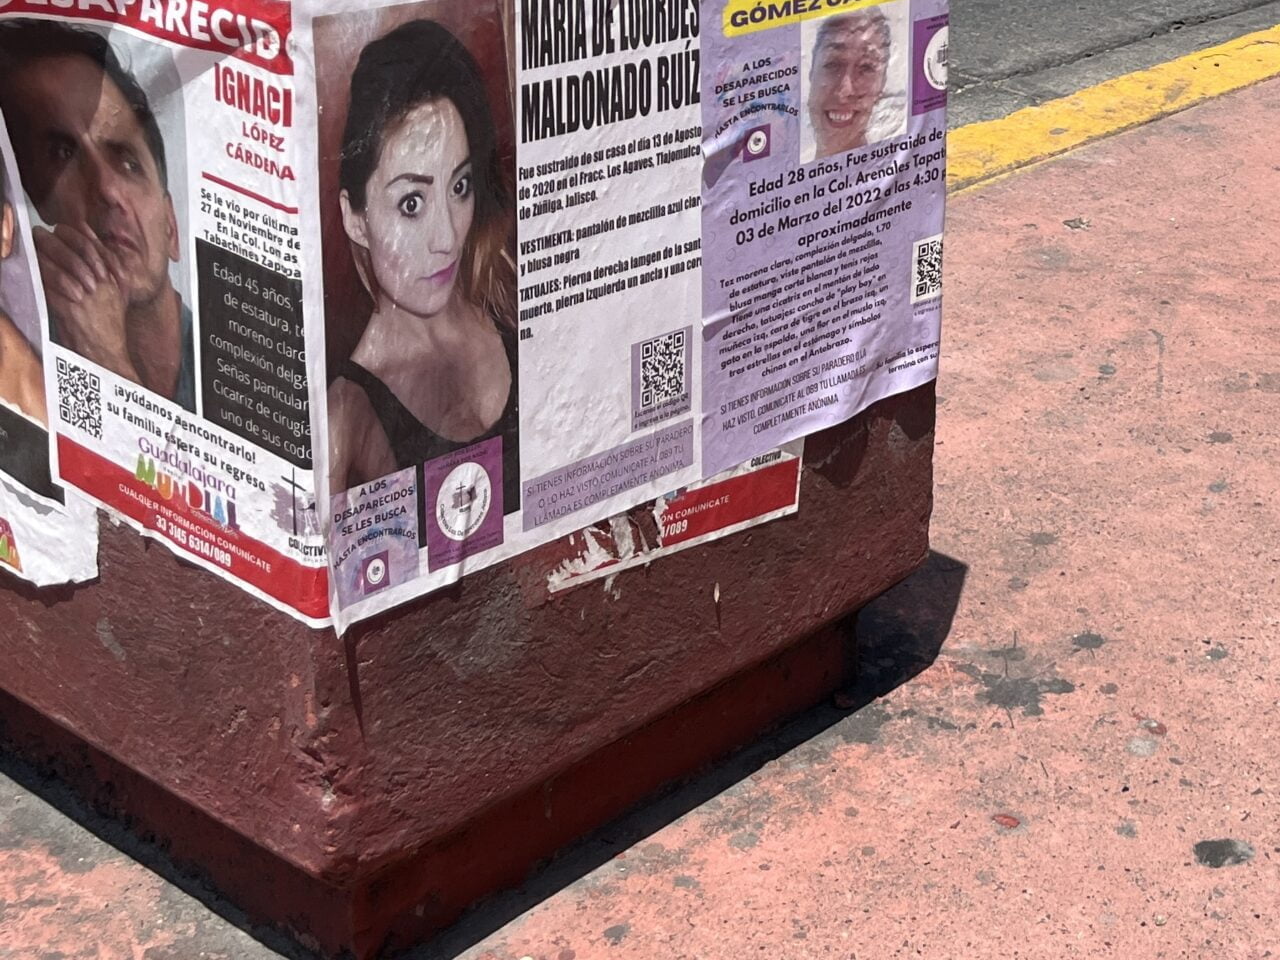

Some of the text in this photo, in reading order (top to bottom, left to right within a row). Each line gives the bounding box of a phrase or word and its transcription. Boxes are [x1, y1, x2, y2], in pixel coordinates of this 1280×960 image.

[730, 0, 821, 28] GÓMEZ
[715, 66, 798, 94] DESAPARECIDOS
[743, 57, 771, 72] A LOS
[521, 40, 701, 144] MALDONADO RUÍZ
[723, 83, 790, 107] SE LES BUSCA
[243, 121, 285, 152] LÓPEZ
[714, 103, 798, 138] HASTA ENCONTRARLOS
[519, 166, 534, 181] Fue
[581, 152, 592, 165] de
[594, 150, 603, 163] su
[606, 145, 626, 160] casa
[628, 141, 636, 154] el
[638, 137, 650, 151] día
[652, 133, 662, 148] 13
[663, 130, 673, 145] de
[675, 126, 702, 143] Agosto
[519, 145, 700, 200] de 2020 en el Fracc. Los Agaves, Tlajomulco
[749, 128, 942, 197] Edad 28 años, Fue sustraida de
[201, 188, 298, 236] Se le vio por última
[519, 189, 598, 220] de Zúñiga, Jalisco.
[730, 198, 791, 226] domicilio
[794, 189, 810, 205] en
[813, 187, 825, 199] la
[828, 176, 851, 194] Col.
[856, 162, 910, 186] Arenales
[736, 170, 939, 246] 03 de Marzo del 2022 a las 4:30
[201, 202, 300, 250] 27 de Noviembre de
[217, 222, 260, 249] En la Col.
[520, 230, 574, 255] VESTIMENTA:
[576, 220, 614, 242] pantalón
[617, 215, 627, 229] de
[629, 205, 665, 226] mezclilla
[668, 198, 682, 215] azul
[798, 199, 912, 248] aproximadamente
[204, 230, 259, 262] Tabachines
[213, 262, 293, 311] Edad 45 años,
[224, 292, 291, 335] de estatura,
[229, 319, 273, 348] moreno
[210, 334, 273, 373] complexión
[217, 358, 250, 385] Señas
[114, 384, 172, 421] ¡ayúdanos
[213, 379, 311, 437] Cicatriz de cirugía
[107, 402, 119, 416] su
[123, 408, 162, 437] familia
[204, 452, 217, 466] su
[221, 460, 265, 491] regreso
[221, 407, 280, 447] uno de sus
[138, 437, 236, 499] Guadalajara
[135, 454, 240, 531] MUNDIAL
[334, 486, 414, 523] DESAPARECIDOS
[359, 480, 387, 497] A LOS
[675, 495, 730, 518] COMUNÍCATE
[342, 505, 407, 536] SE LES BUSCA
[156, 514, 232, 568] 33 3145 6314/089
[217, 536, 272, 573] COMUNÍCATE
[334, 527, 416, 570] HASTA ENCONTRARLOS
